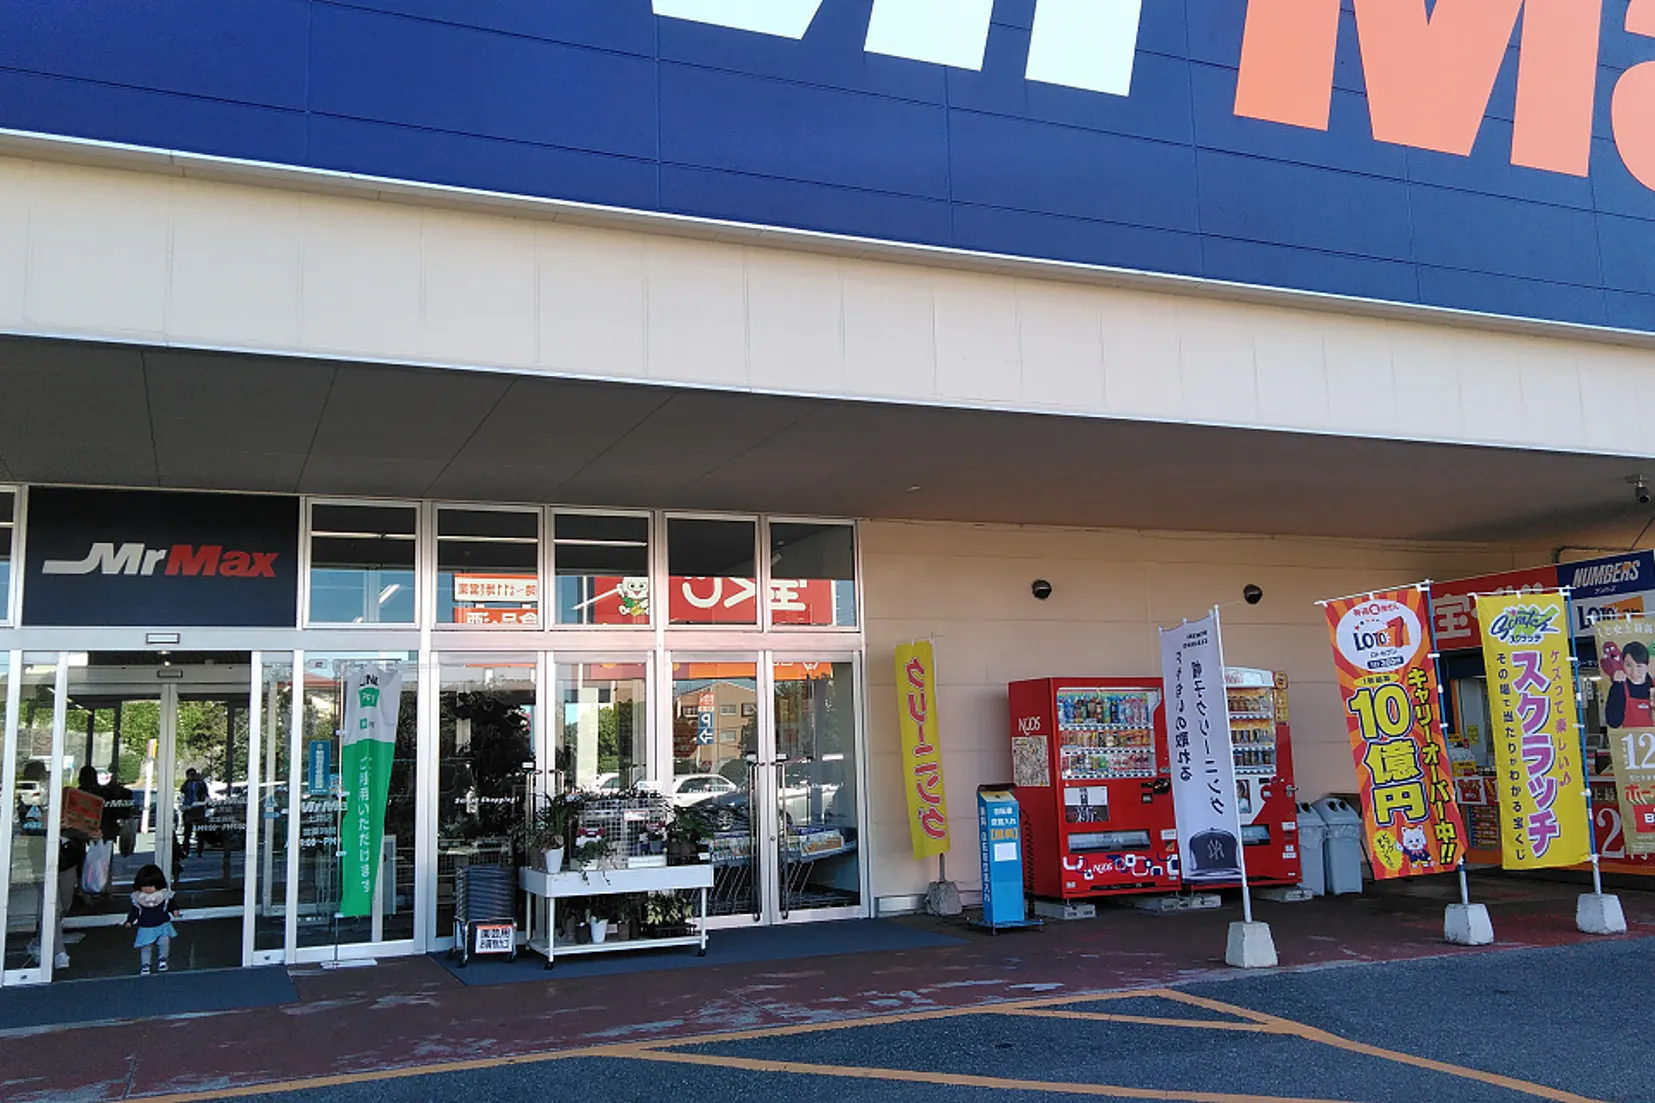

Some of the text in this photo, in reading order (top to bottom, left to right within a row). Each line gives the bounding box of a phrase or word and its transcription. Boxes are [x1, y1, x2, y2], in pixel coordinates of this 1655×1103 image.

[42, 542, 279, 578] MrMax
[1572, 560, 1641, 588] NUMBERS
[1512, 650, 1561, 858] スクラッチ
